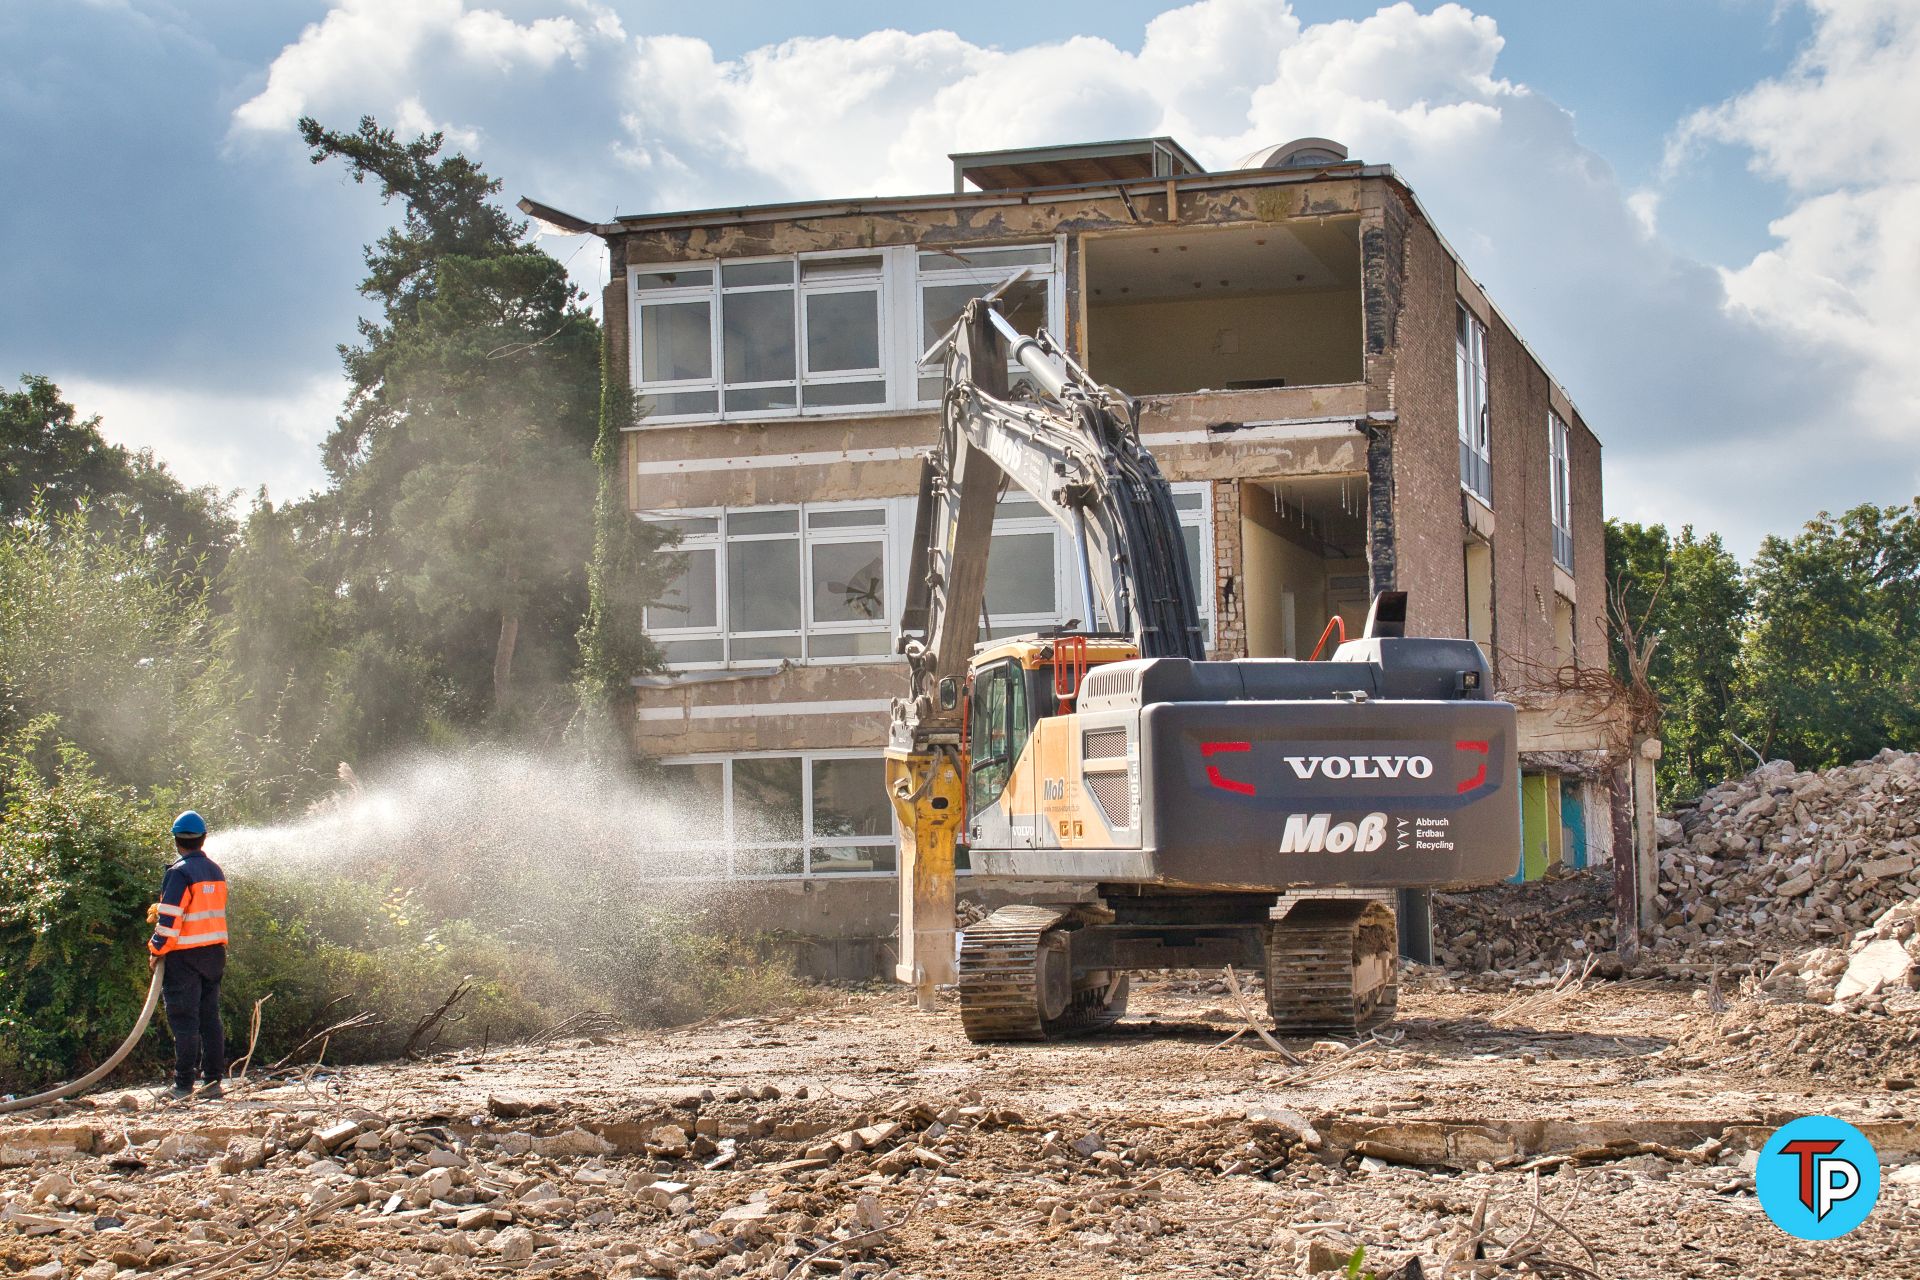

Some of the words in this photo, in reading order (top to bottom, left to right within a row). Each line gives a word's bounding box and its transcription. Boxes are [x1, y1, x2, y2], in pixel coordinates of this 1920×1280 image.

[1283, 755, 1433, 779] VOLVO
[1043, 778, 1064, 801] Moß
[1415, 817, 1449, 826] Abbruch
[1012, 825, 1035, 837] VOLVO
[1279, 812, 1388, 853] Moß
[1416, 829, 1444, 838] Erdbau
[1416, 840, 1454, 851] Recycling
